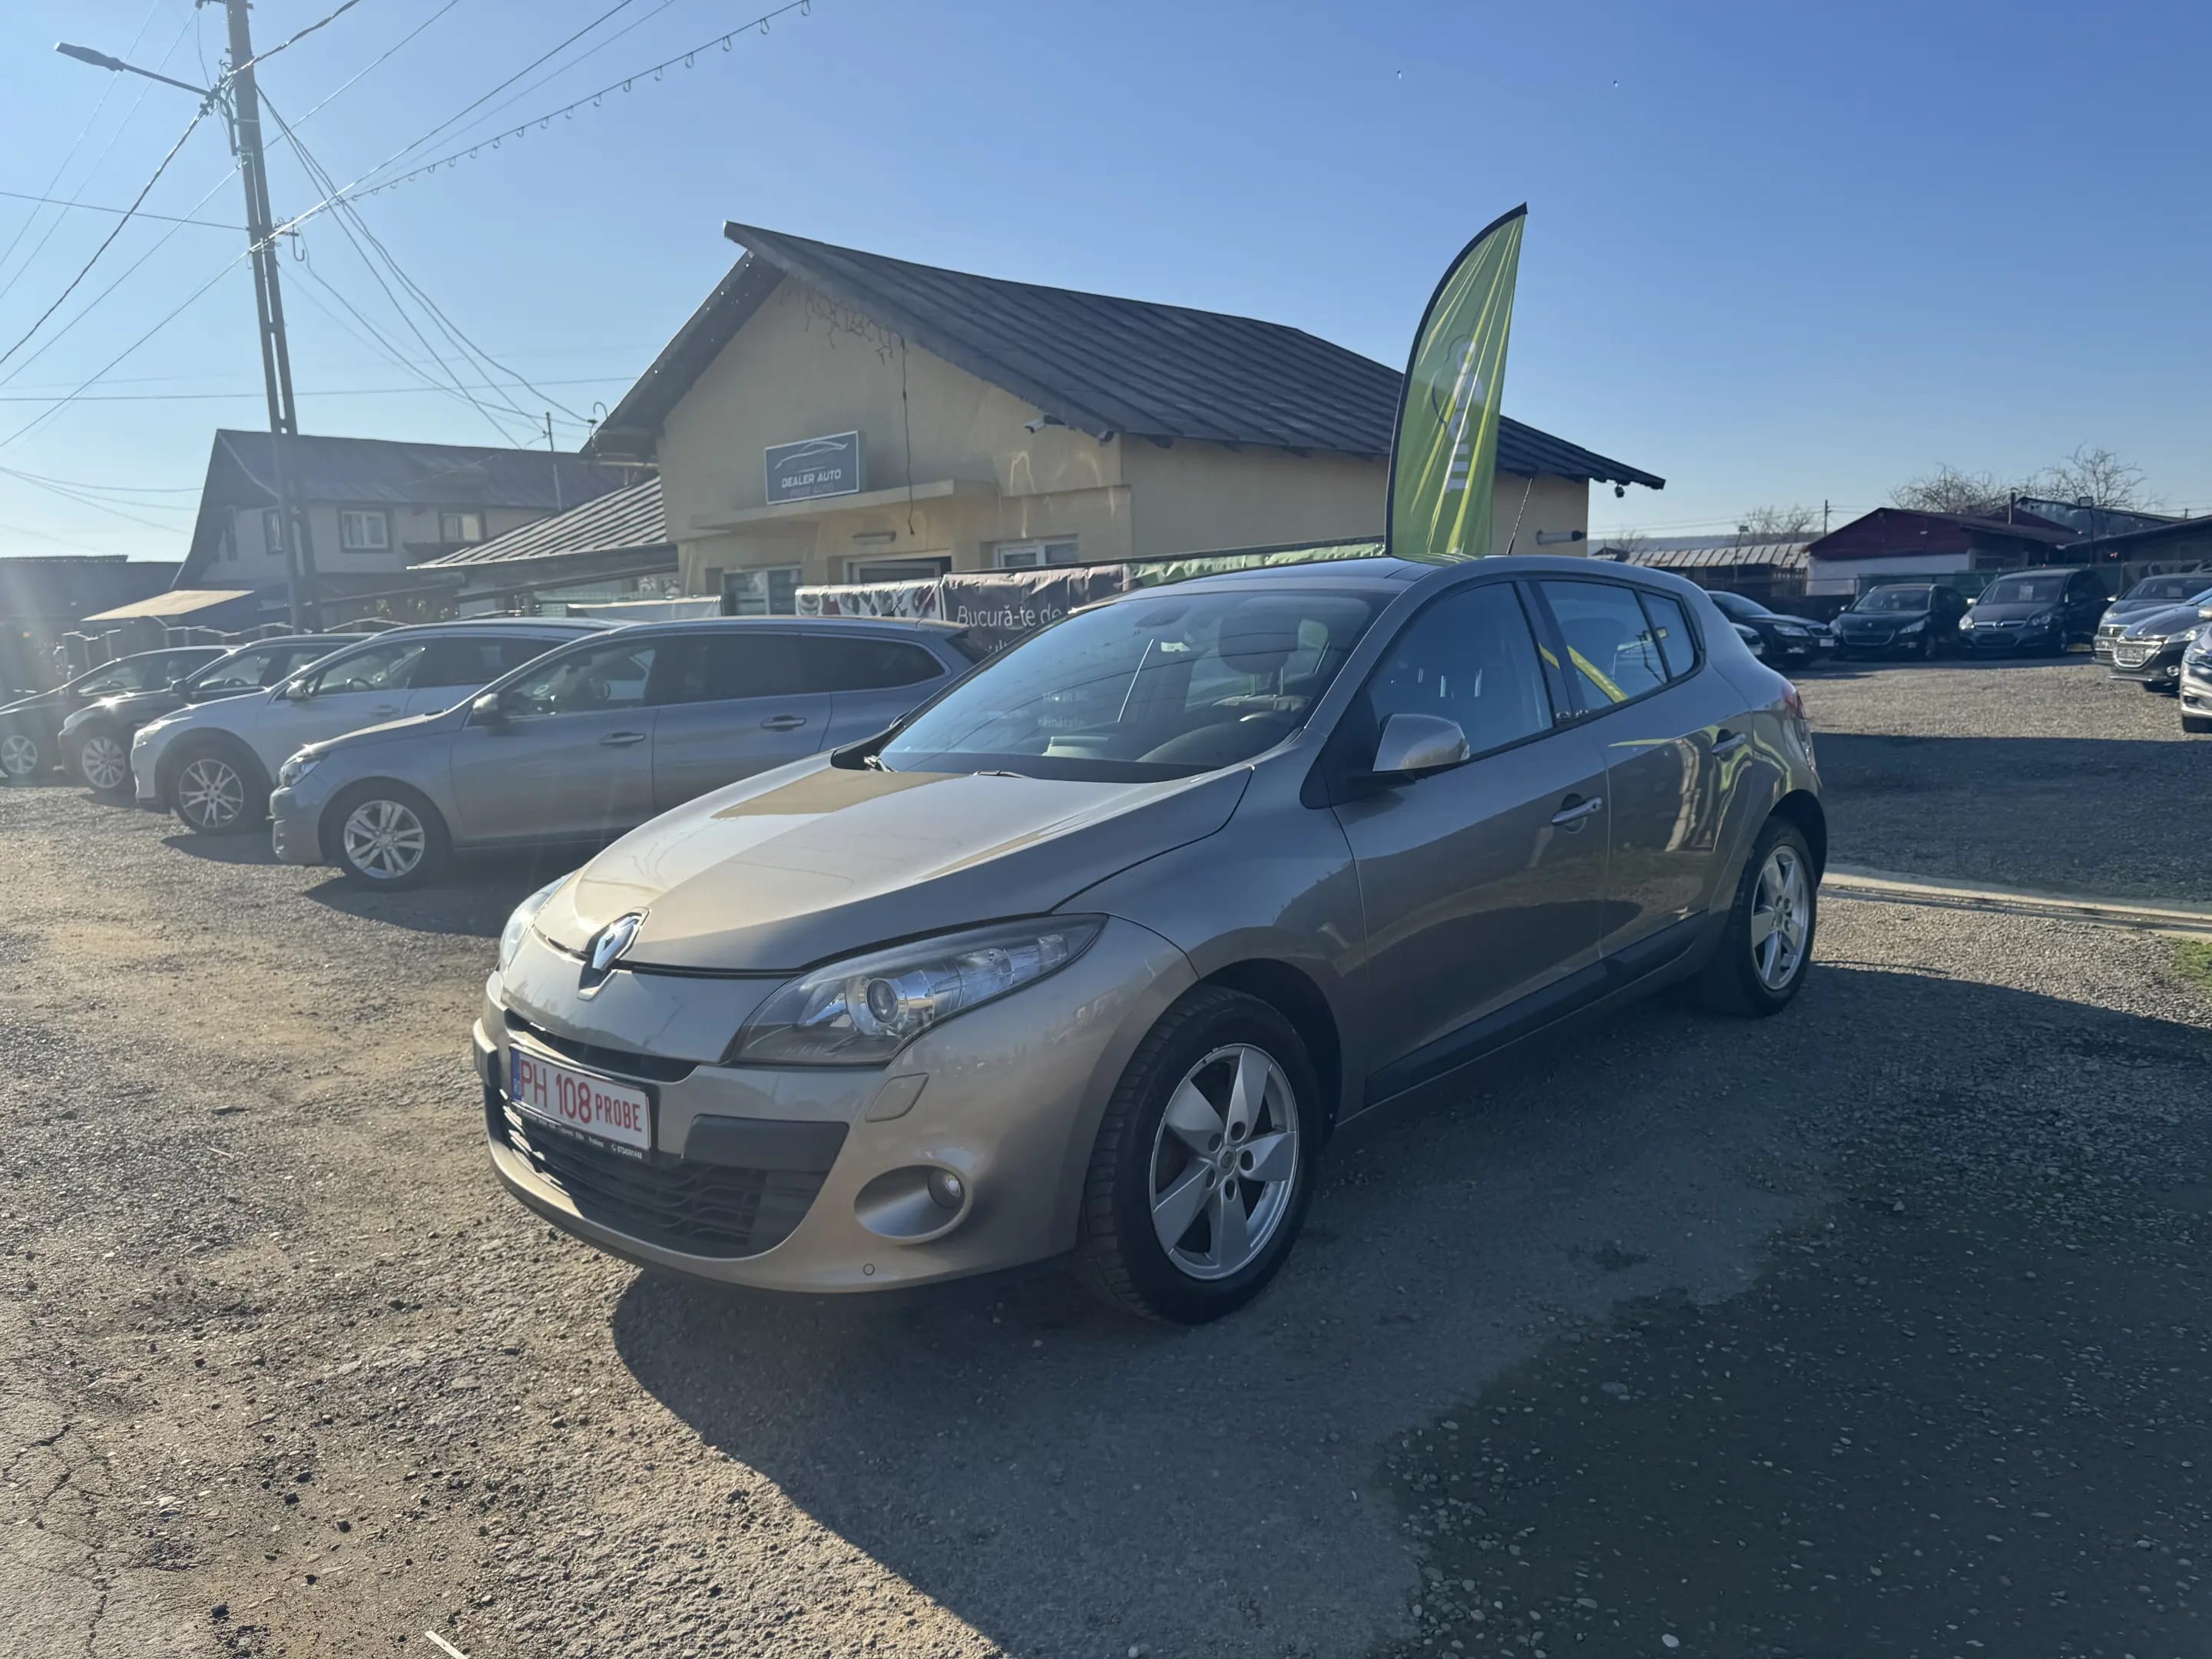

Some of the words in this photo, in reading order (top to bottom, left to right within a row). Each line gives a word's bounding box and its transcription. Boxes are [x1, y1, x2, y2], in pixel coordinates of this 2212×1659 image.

[782, 474, 814, 488] DEALER
[817, 469, 842, 482] AUTO
[957, 605, 1036, 628] Bucură-te
[1040, 602, 1061, 624] de
[520, 1060, 548, 1108] PH
[556, 1073, 592, 1124] 108
[595, 1093, 642, 1132] PROBE
